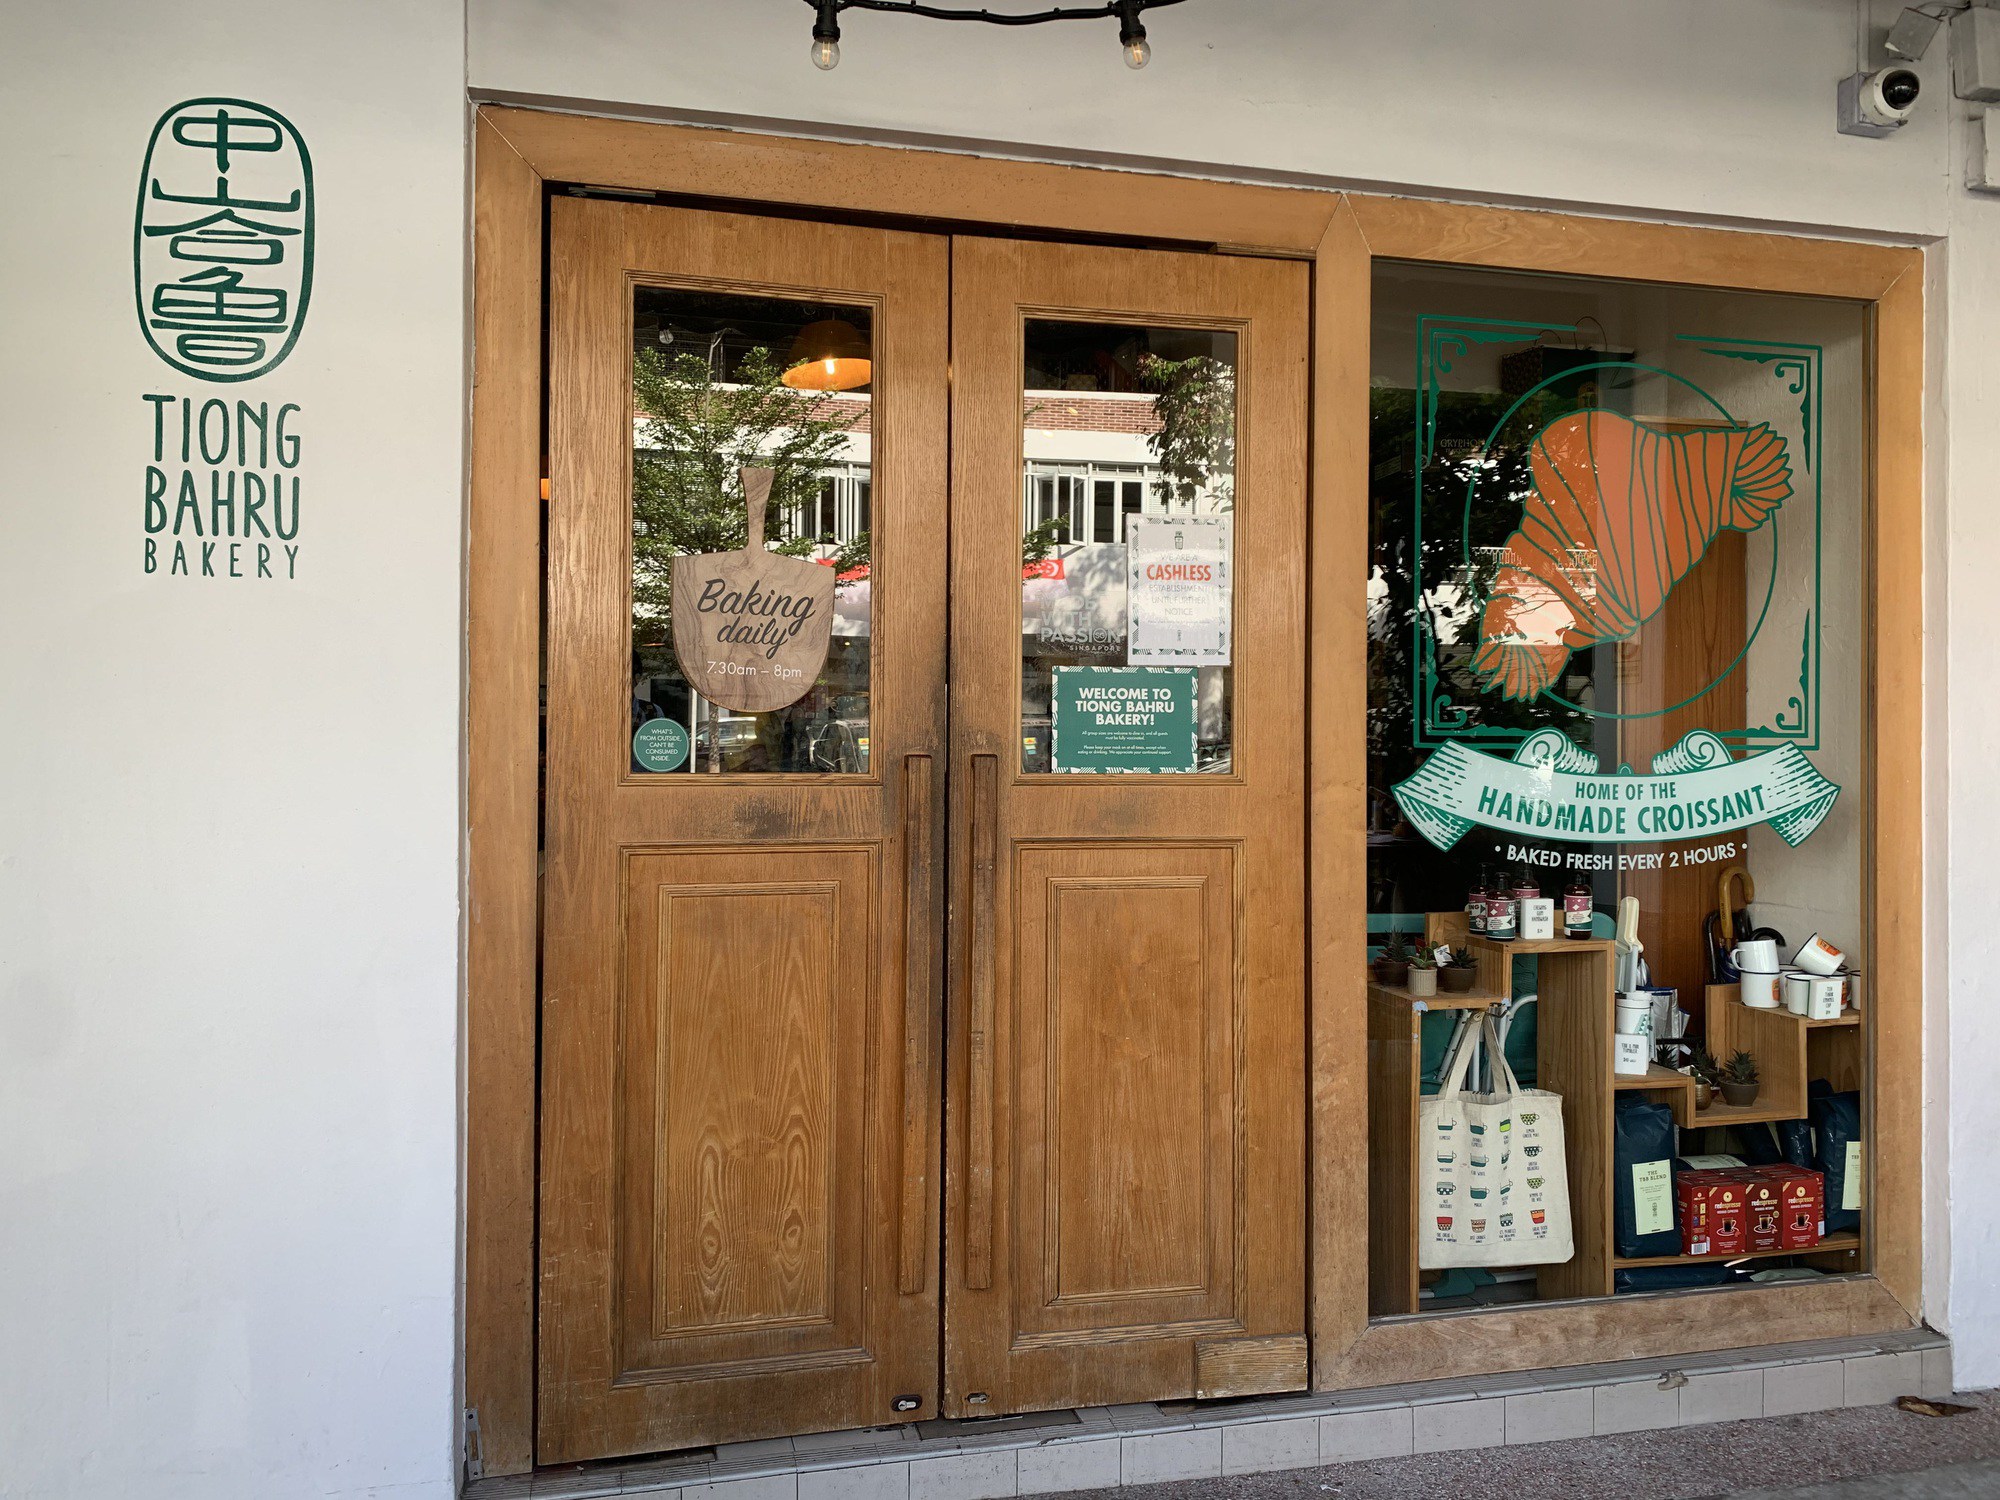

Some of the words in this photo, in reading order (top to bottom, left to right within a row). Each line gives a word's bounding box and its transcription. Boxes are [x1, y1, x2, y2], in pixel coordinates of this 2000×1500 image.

[142, 394, 301, 470] TIONG
[1440, 438, 1483, 448] GRYPHO
[145, 465, 301, 541] BAHRU
[144, 540, 299, 580] BAKERY
[1146, 564, 1212, 581] CASHLESS
[697, 578, 816, 637] Baking
[1165, 608, 1194, 616] NOTICE
[717, 616, 789, 660] daily
[1041, 628, 1121, 643] PASSION
[706, 661, 757, 677] 7.30am
[774, 664, 802, 680] 8pm
[1079, 688, 1148, 700] WELCOME
[1152, 688, 1172, 700] TO
[1075, 700, 1122, 712] TIONG
[1126, 701, 1175, 713] BAHRU
[1096, 714, 1155, 726] BAKERY!
[1575, 781, 1619, 800] HOME
[1625, 784, 1644, 800] OF
[1650, 781, 1677, 800] THE
[1477, 785, 1626, 835] HANDMADE
[1637, 784, 1767, 834] CROISSANT
[1506, 844, 1562, 868] BAKED
[1566, 853, 1613, 871] FRESH
[1618, 852, 1665, 871] EVERY
[1669, 851, 1680, 868] 2
[1683, 842, 1737, 866] HOURS
